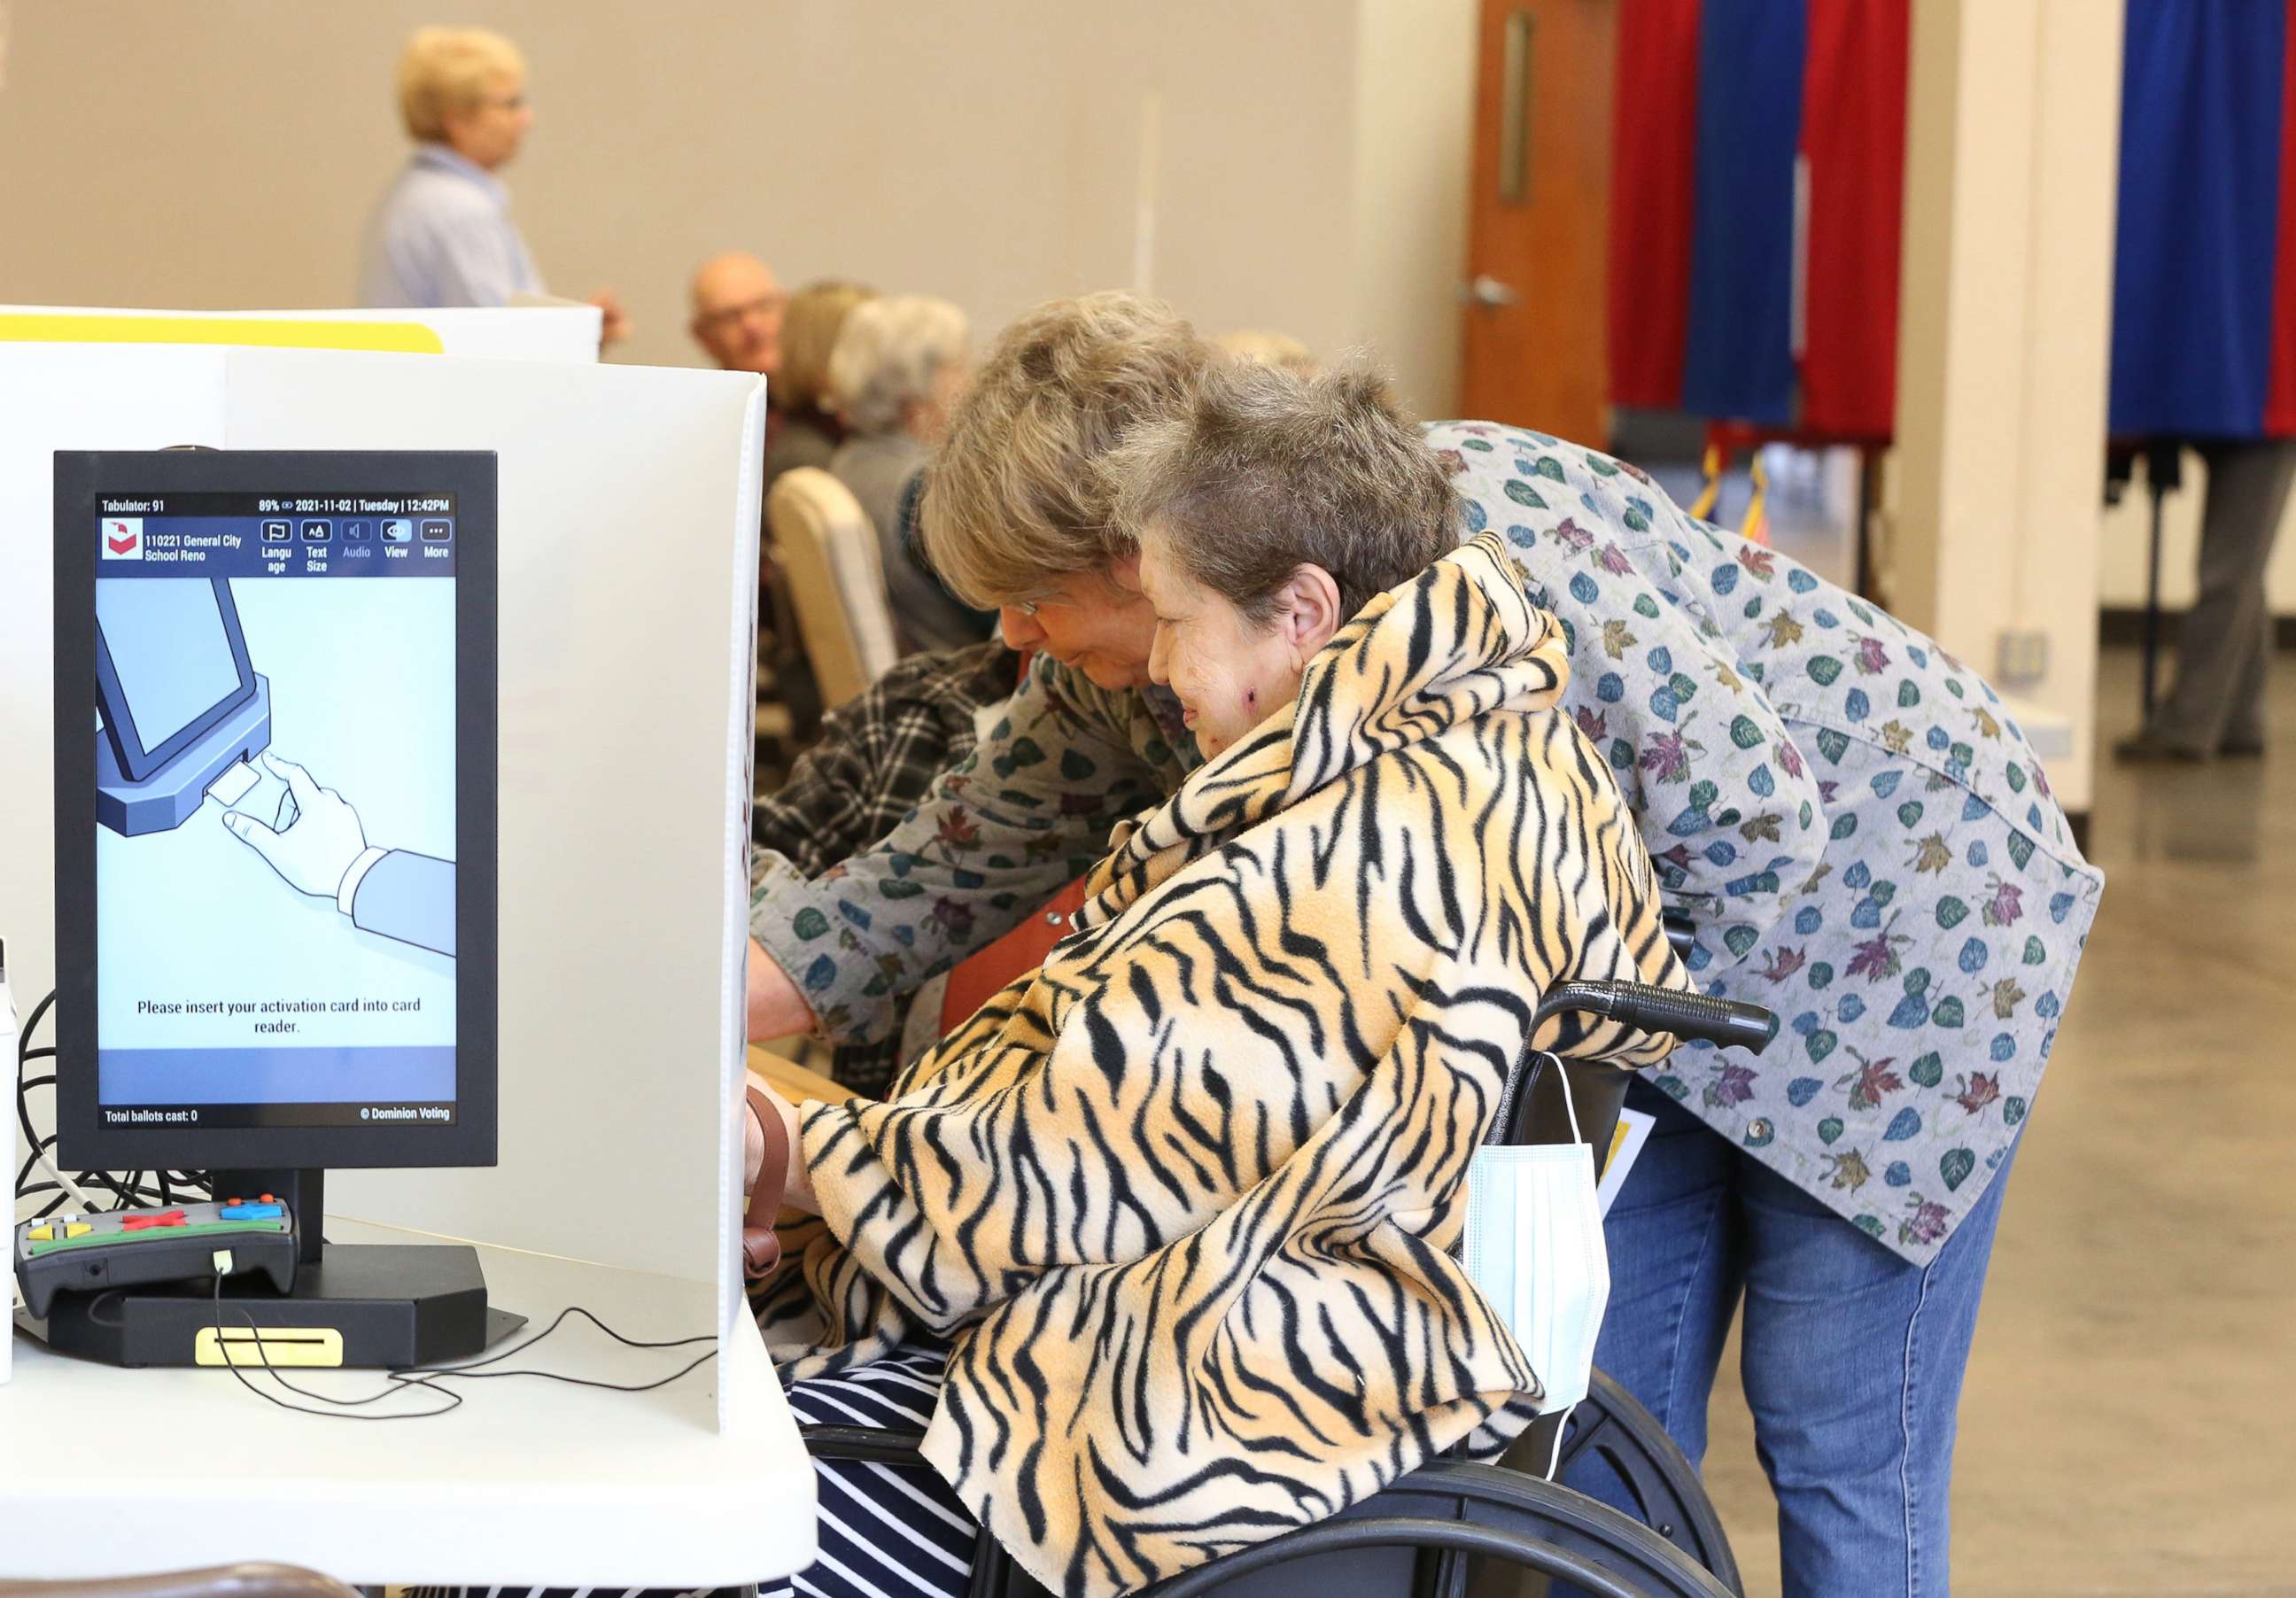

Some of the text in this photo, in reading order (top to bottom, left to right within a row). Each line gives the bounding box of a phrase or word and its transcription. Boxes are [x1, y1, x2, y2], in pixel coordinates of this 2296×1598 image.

[102, 500, 165, 512] Tabulator: 91
[259, 500, 280, 512] 89%
[295, 500, 352, 512] 2021-11-02
[359, 500, 399, 514] Tuesday
[407, 500, 450, 512] 12:42PM
[145, 535, 242, 549] 110221 General City
[144, 550, 206, 562] School Reno
[261, 547, 291, 560] Langu
[306, 547, 328, 558] Text
[343, 547, 371, 558] Audio
[384, 547, 408, 558] View
[424, 547, 449, 558] More
[268, 562, 286, 574] age
[306, 561, 328, 572] Size
[137, 997, 422, 1016] Please insert your activation card into card
[254, 1019, 301, 1033] reader.
[105, 1109, 198, 1122] Total ballots cast: 0
[371, 1106, 417, 1119] Dominion
[419, 1106, 450, 1121] Voting
